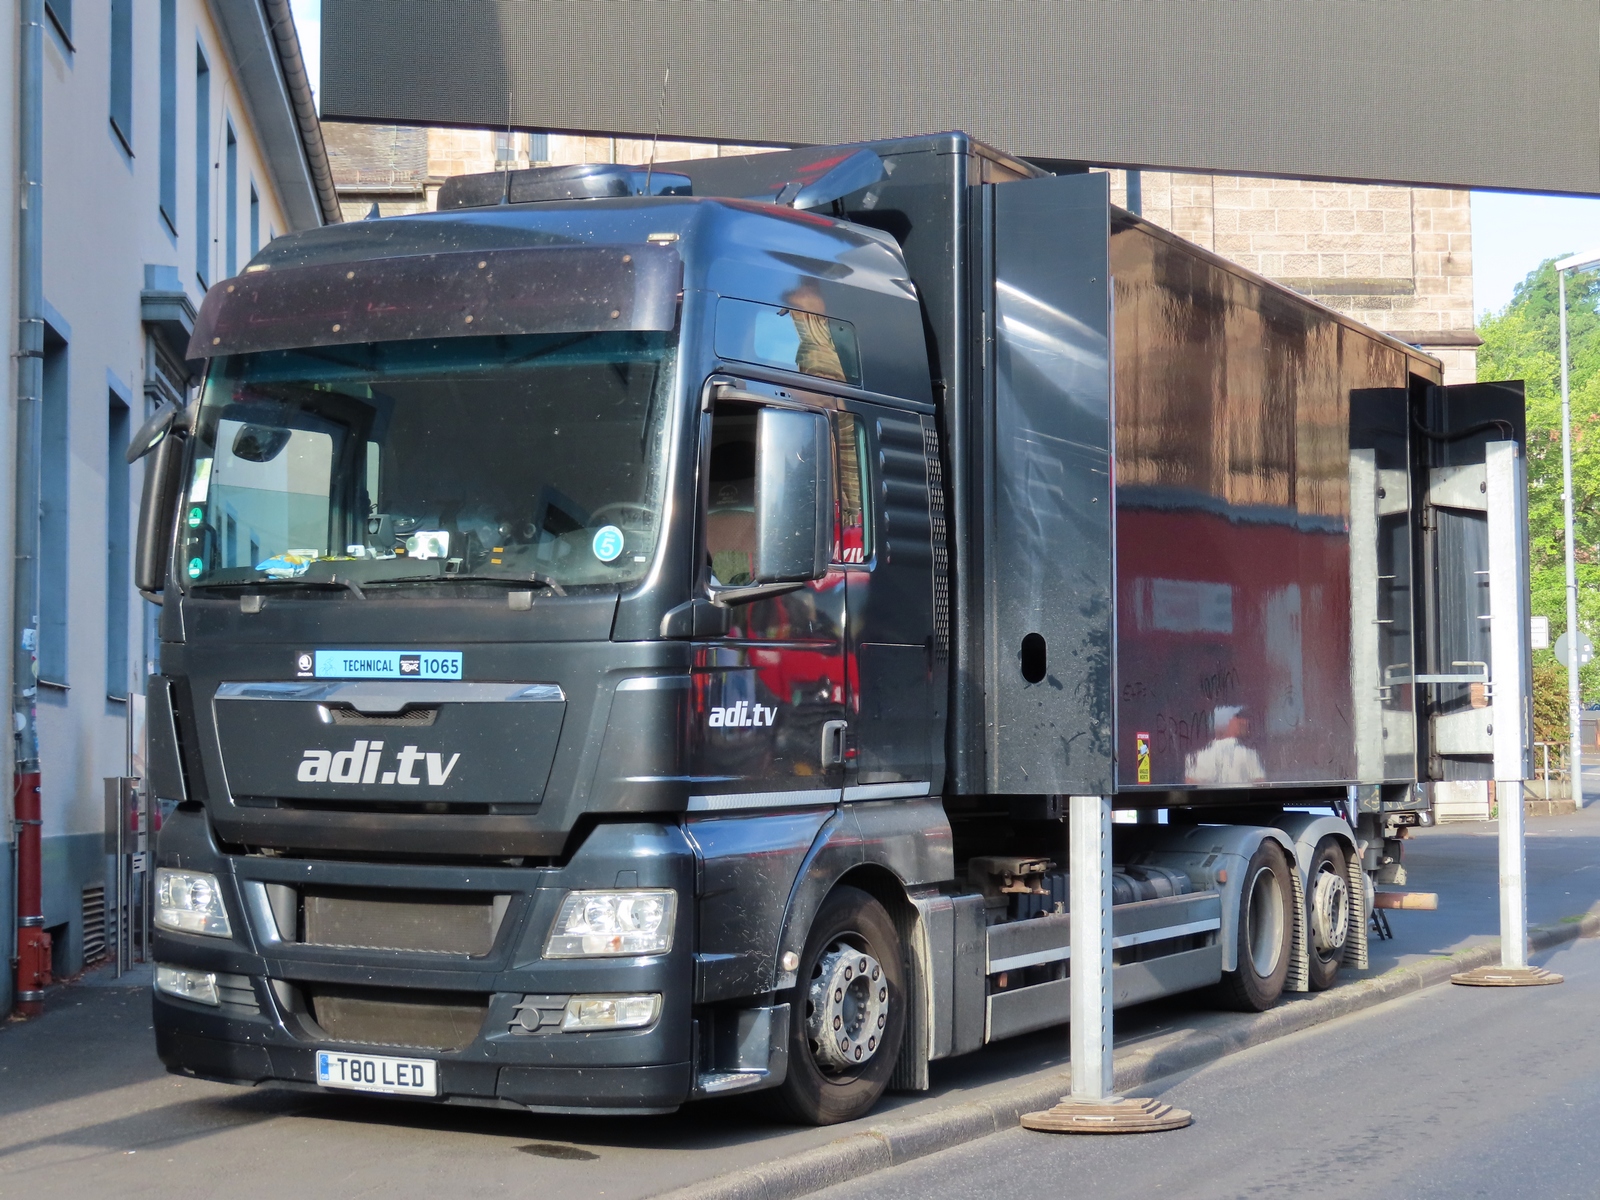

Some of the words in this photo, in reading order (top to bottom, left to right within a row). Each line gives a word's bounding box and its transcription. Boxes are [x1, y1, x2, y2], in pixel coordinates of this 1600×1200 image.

[599, 538, 615, 556] 5
[343, 659, 394, 672] TECHNICAL
[423, 659, 459, 674] 1065
[708, 701, 778, 727] adi.tv
[297, 740, 461, 786] adi.tv
[337, 1058, 376, 1083] T80
[382, 1062, 424, 1087] LED
